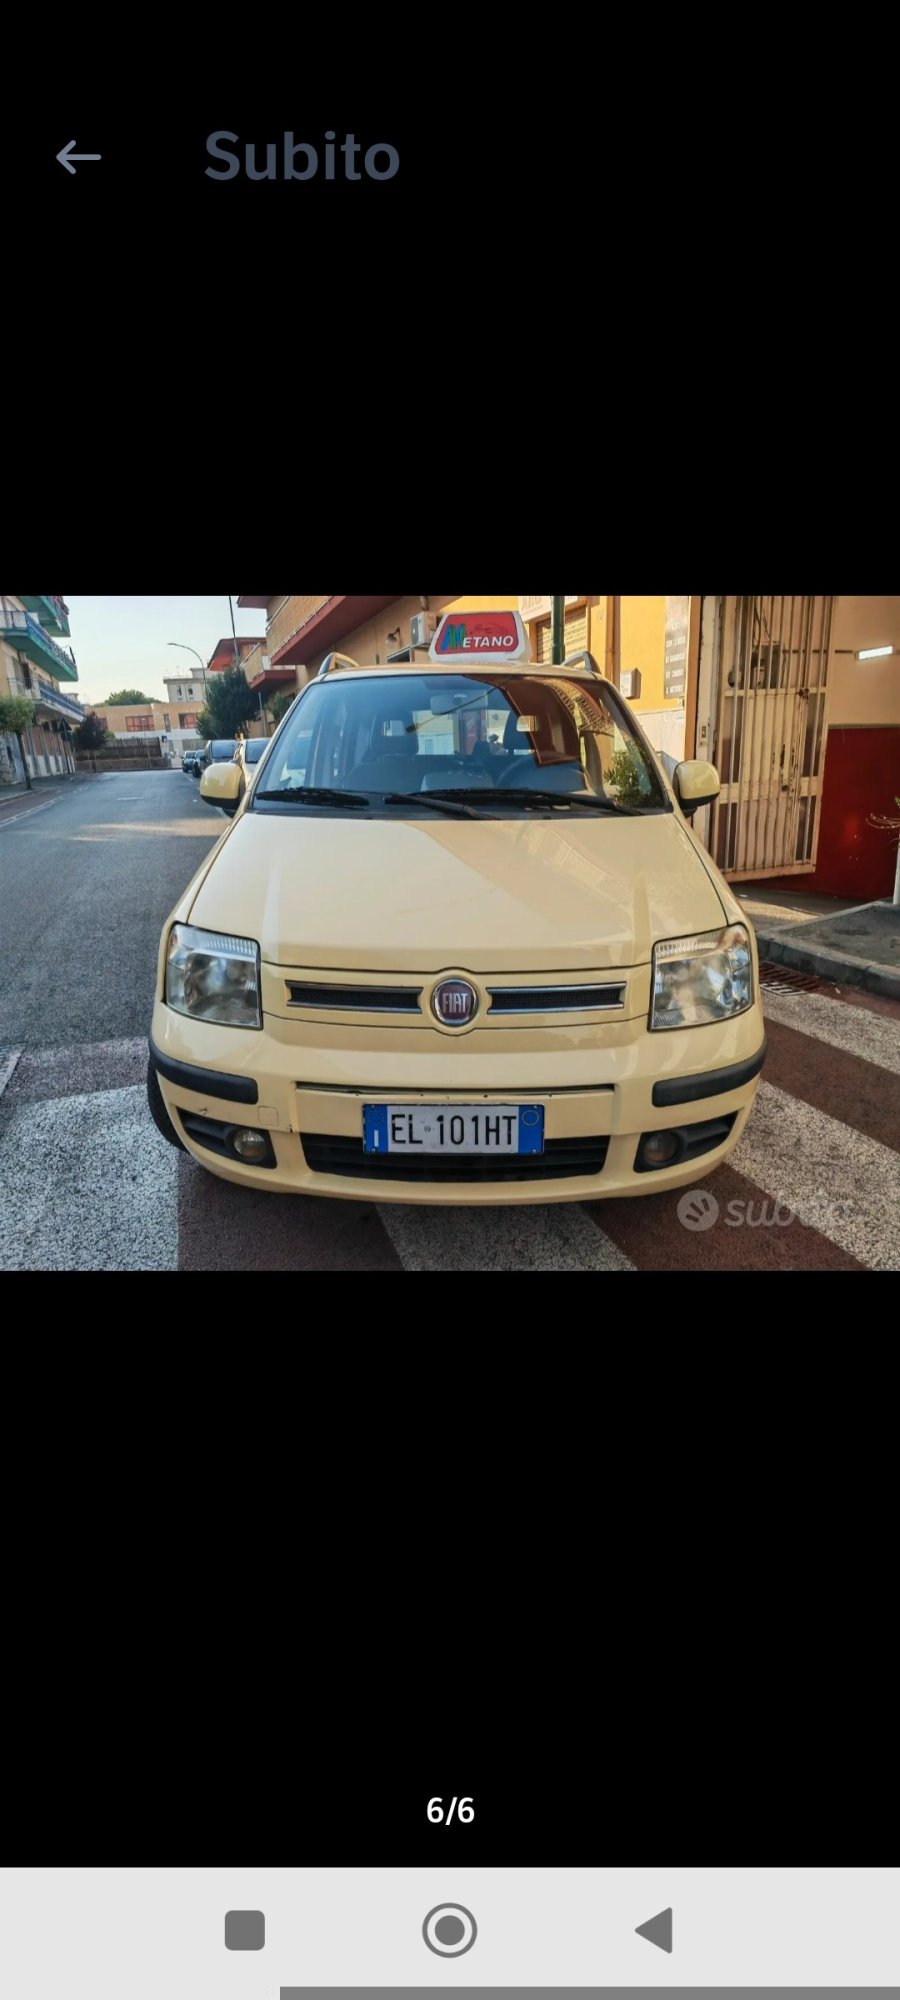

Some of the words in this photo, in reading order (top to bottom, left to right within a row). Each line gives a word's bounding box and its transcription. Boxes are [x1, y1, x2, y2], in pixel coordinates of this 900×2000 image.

[440, 623, 514, 652] METANO
[442, 992, 468, 1014] FIAT
[391, 1114, 423, 1145] EL
[436, 1115, 517, 1145] 101HT
